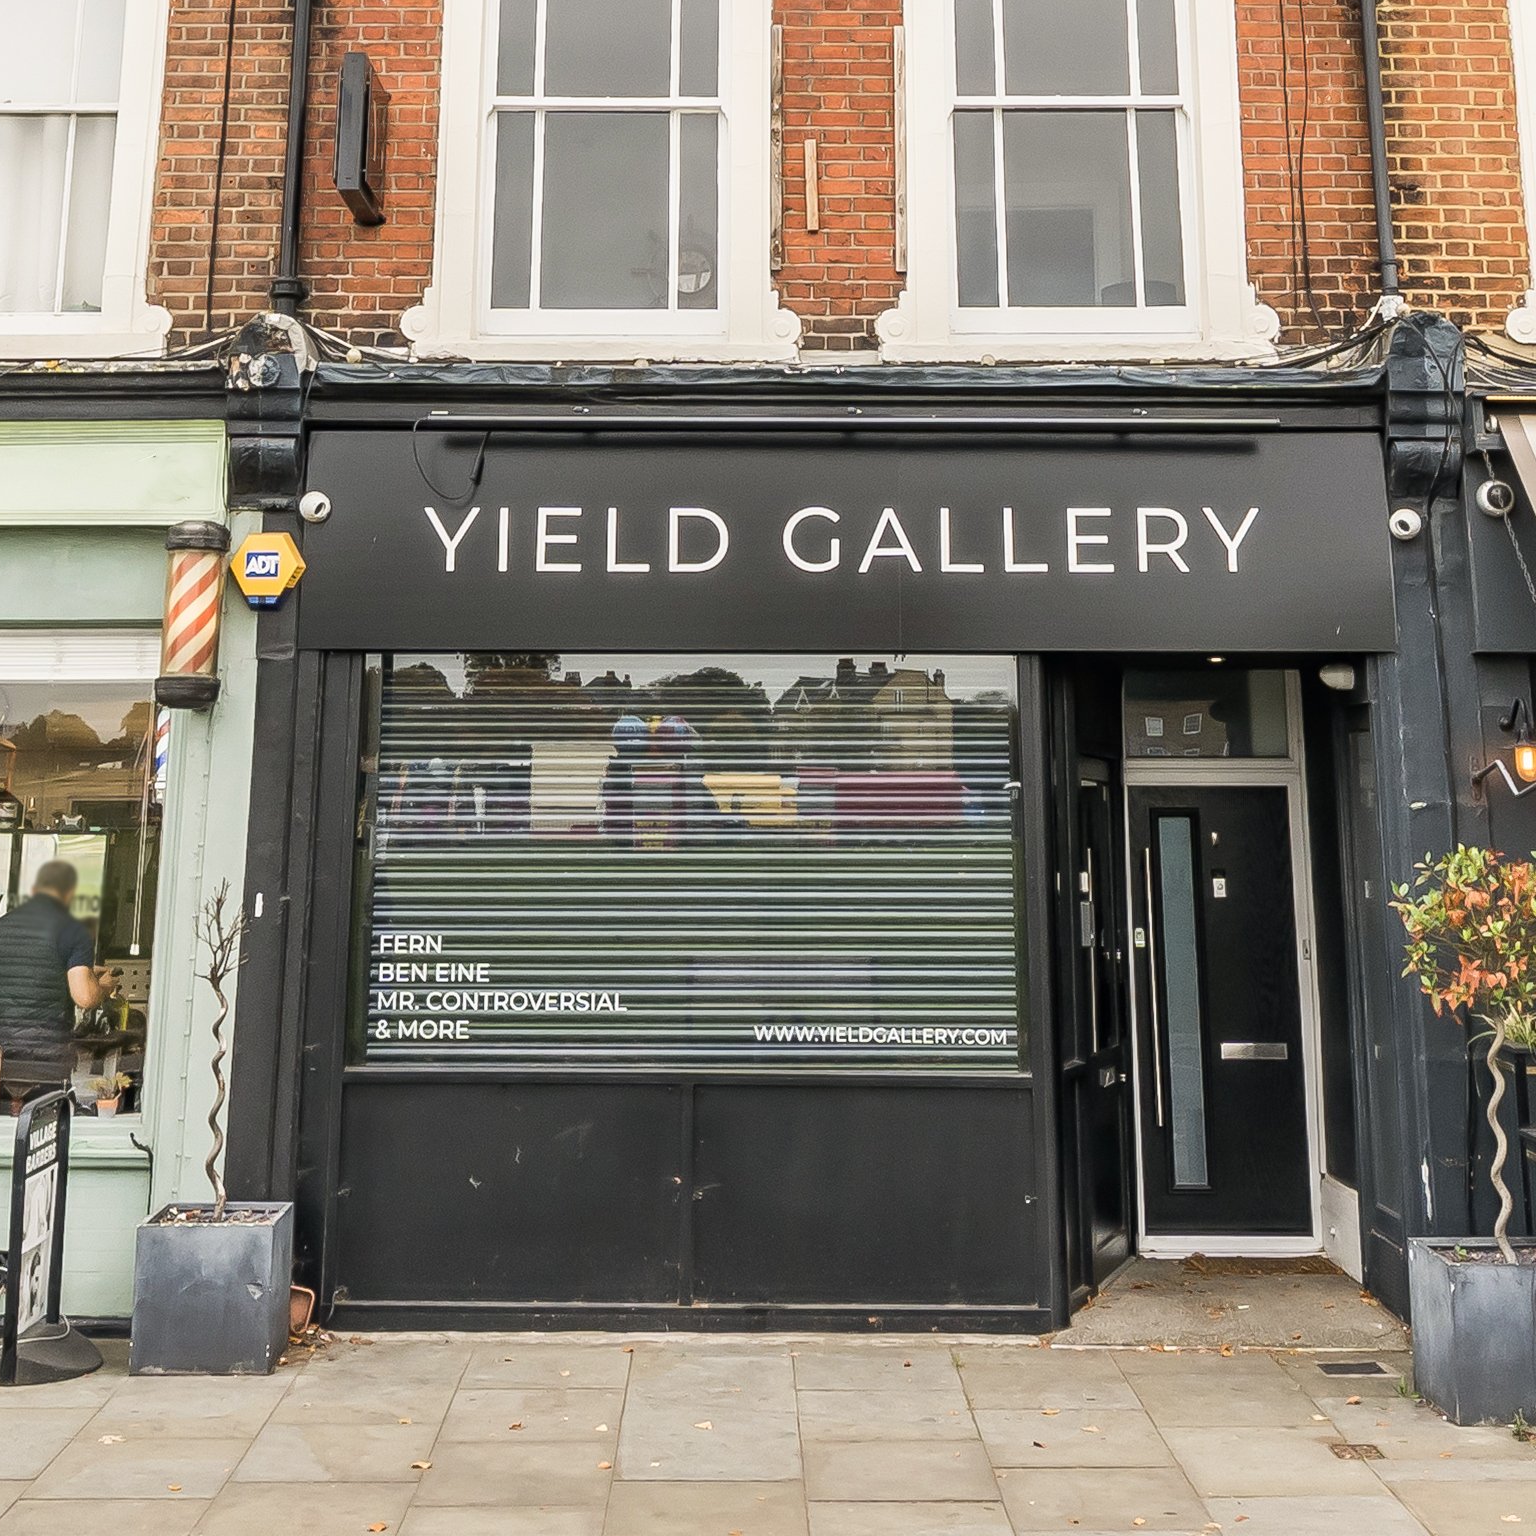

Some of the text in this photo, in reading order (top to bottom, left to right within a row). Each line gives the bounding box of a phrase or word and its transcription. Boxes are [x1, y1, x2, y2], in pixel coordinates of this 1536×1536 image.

[423, 506, 1261, 574] YIELD GALLERY
[246, 555, 280, 574] ADT
[379, 934, 442, 954] FERN
[378, 963, 490, 983] BEN EINE
[377, 991, 627, 1012] MR. CONTROVERSIAL
[375, 1019, 469, 1040] & MORE
[753, 1025, 1007, 1045] WWW.YIELDGALLERY.COM
[29, 1120, 57, 1151] VILLAGE
[26, 1142, 56, 1174] BARBERS
